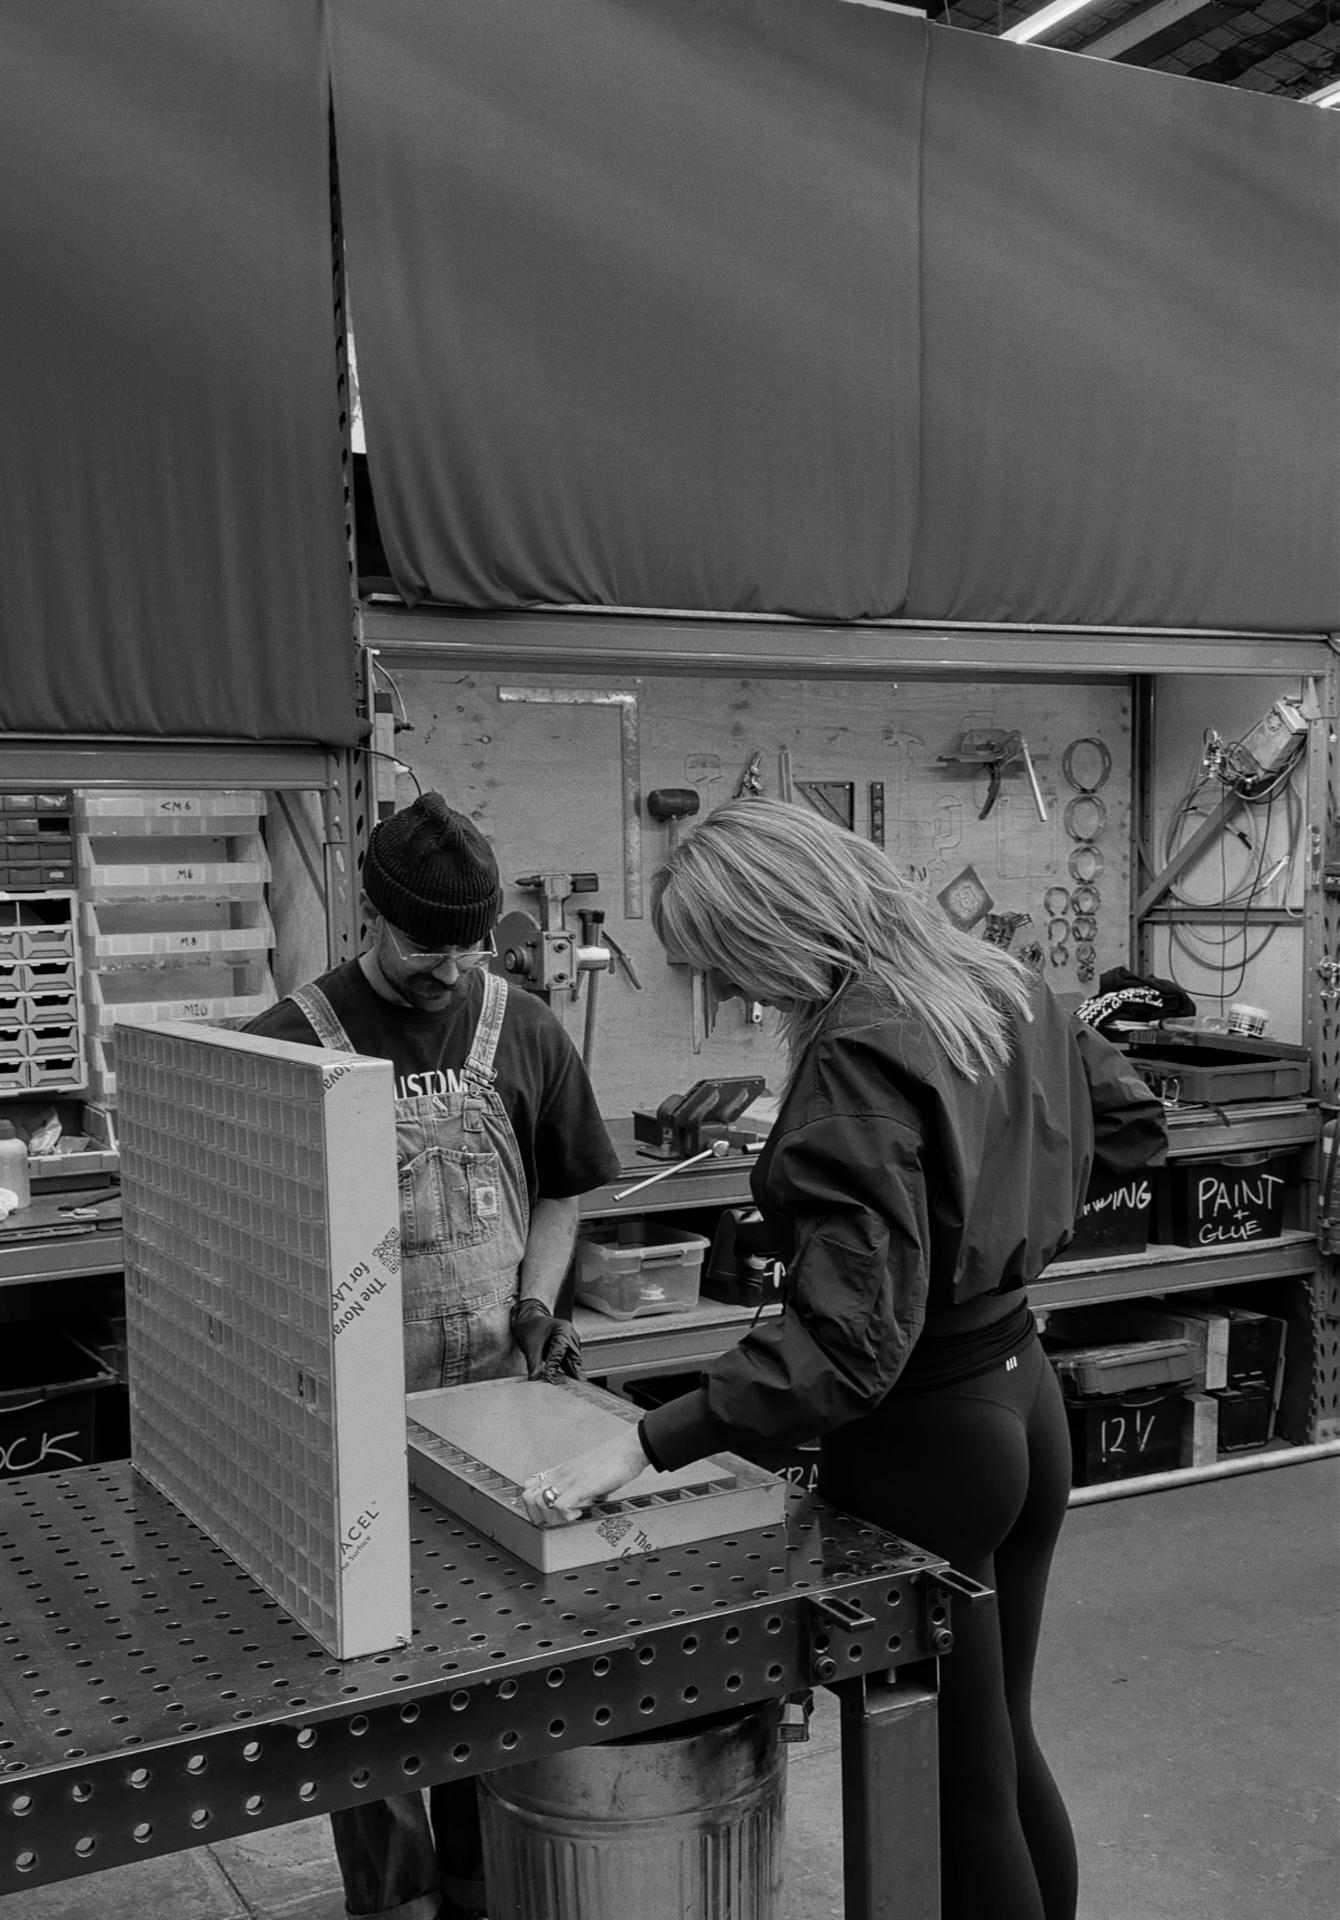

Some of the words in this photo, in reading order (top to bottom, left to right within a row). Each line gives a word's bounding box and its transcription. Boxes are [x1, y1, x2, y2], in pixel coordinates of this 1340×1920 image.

[1198, 1173, 1284, 1219] PAINT
[1233, 1209, 1250, 1220] +
[1199, 1220, 1262, 1244] GLUE
[349, 1261, 371, 1284] for
[360, 1277, 388, 1302] The
[333, 1300, 366, 1338] Nova
[0, 1430, 83, 1471] CK
[340, 1509, 380, 1556] ACEL
[633, 1530, 652, 1552] The
